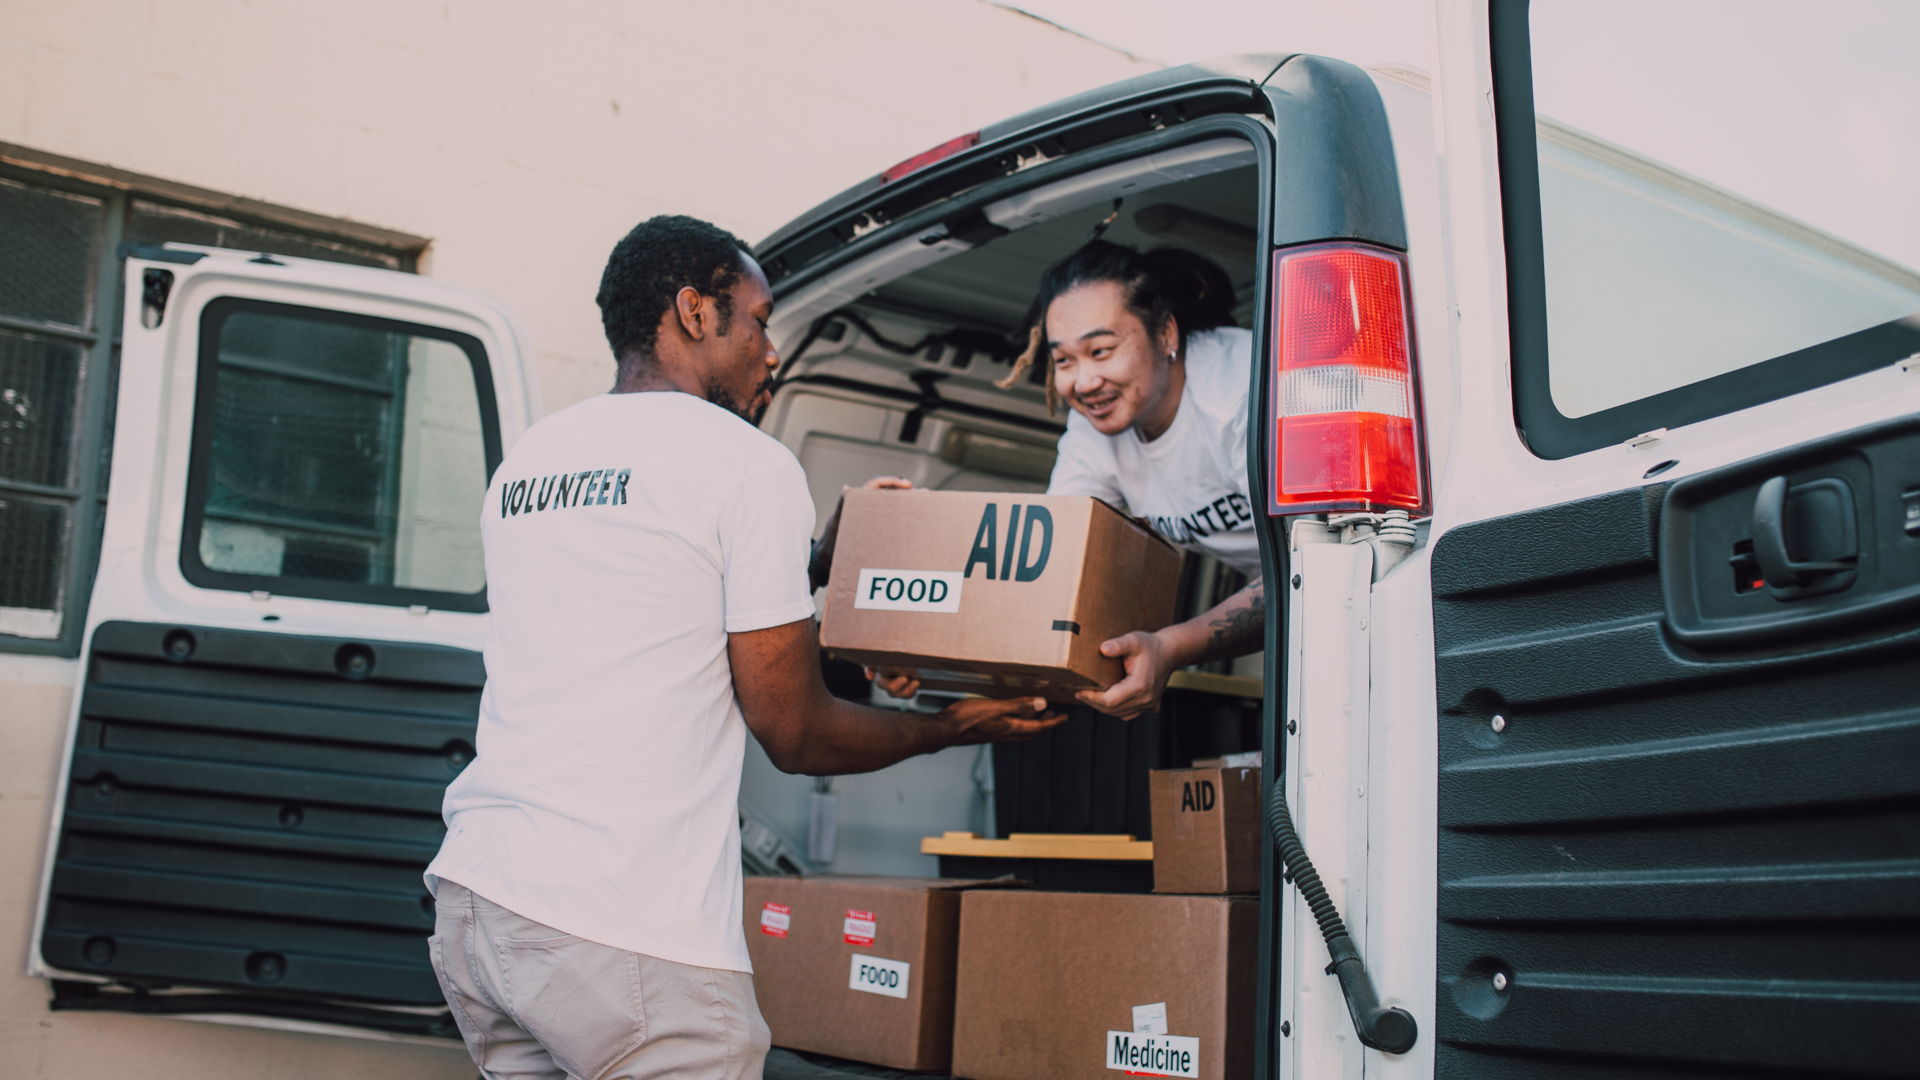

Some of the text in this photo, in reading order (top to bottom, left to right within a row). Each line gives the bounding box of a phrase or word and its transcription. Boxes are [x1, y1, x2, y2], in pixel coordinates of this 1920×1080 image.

[502, 468, 632, 519] VOLUNTEER
[964, 503, 1053, 582] AID
[869, 577, 948, 603] FOOD
[1182, 780, 1215, 812] AID
[859, 964, 899, 988] FOOD
[1114, 1035, 1191, 1073] Medicine
